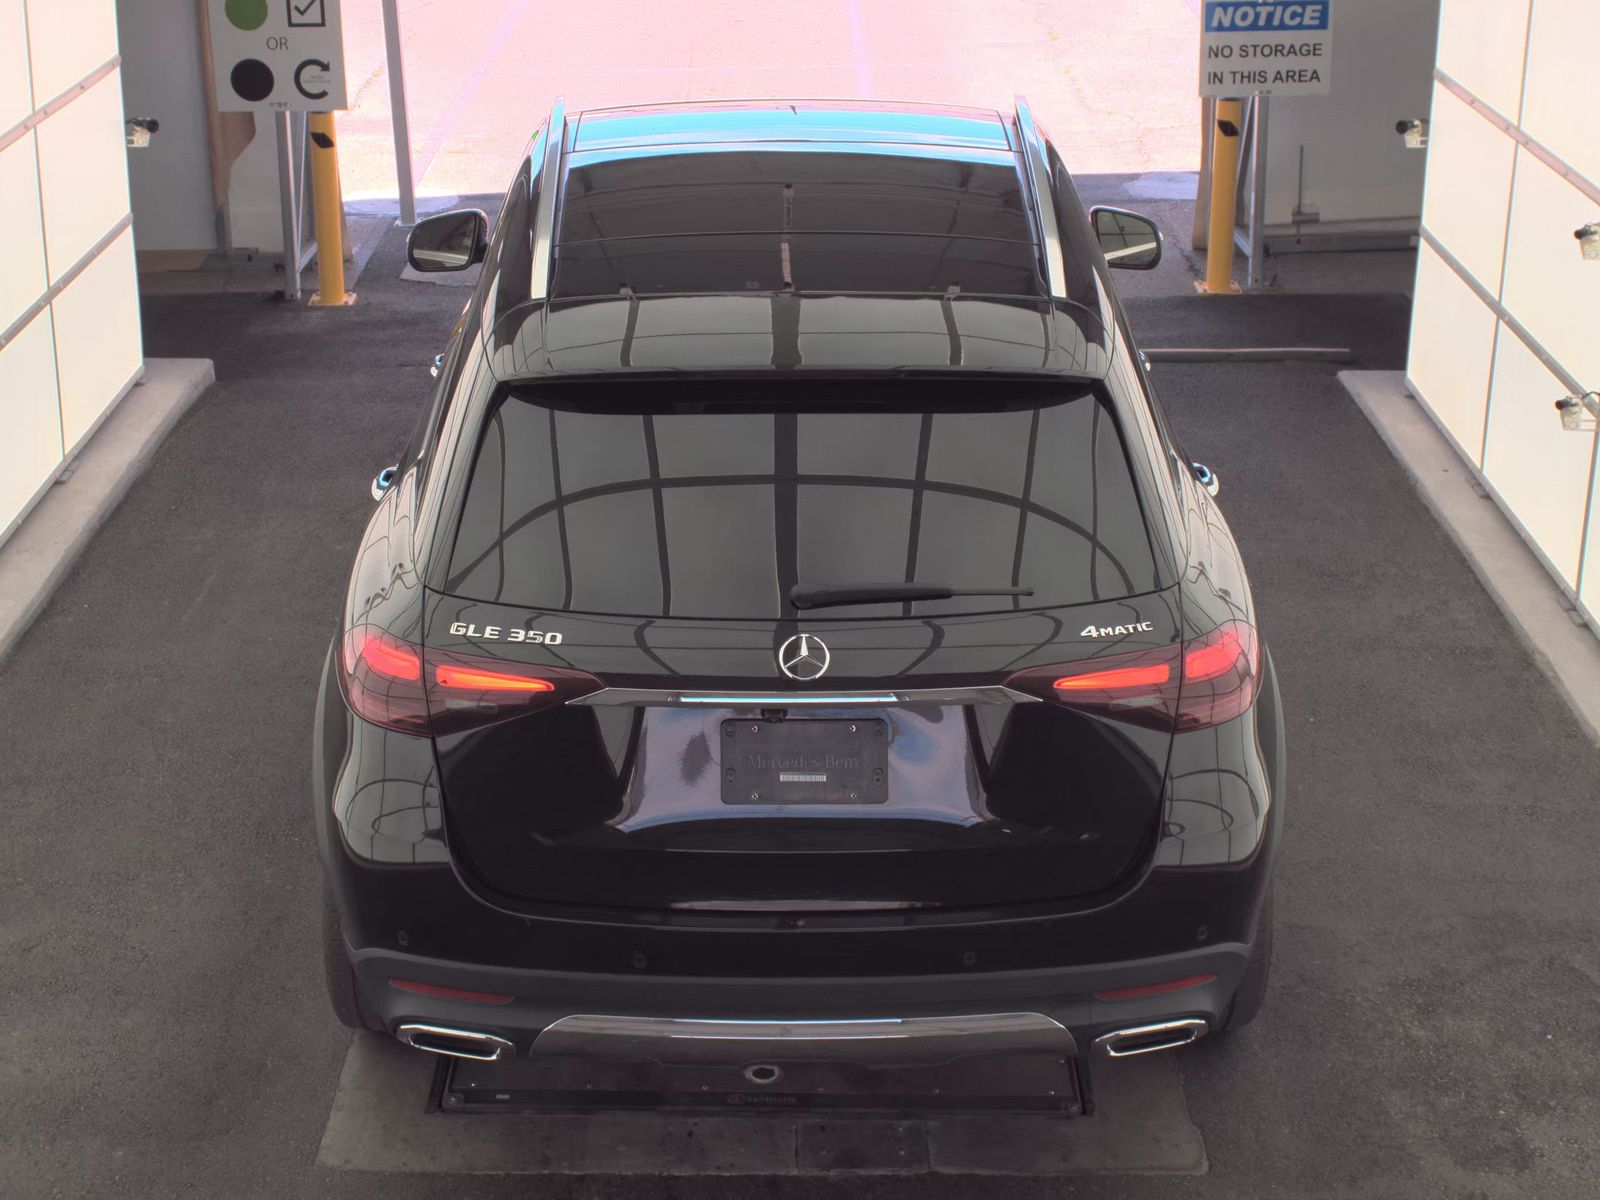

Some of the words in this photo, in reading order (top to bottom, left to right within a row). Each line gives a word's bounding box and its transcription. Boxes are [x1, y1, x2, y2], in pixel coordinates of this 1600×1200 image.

[1211, 4, 1323, 27] NOTICE
[266, 36, 289, 50] OR
[1207, 45, 1233, 59] NO
[1238, 43, 1323, 58] STORAGE
[1207, 71, 1223, 85] IN
[1230, 70, 1268, 84] THIS
[1272, 69, 1321, 83] AREA
[449, 622, 502, 639] GLE
[507, 628, 563, 645] 350
[1080, 621, 1154, 638] 4MATIC
